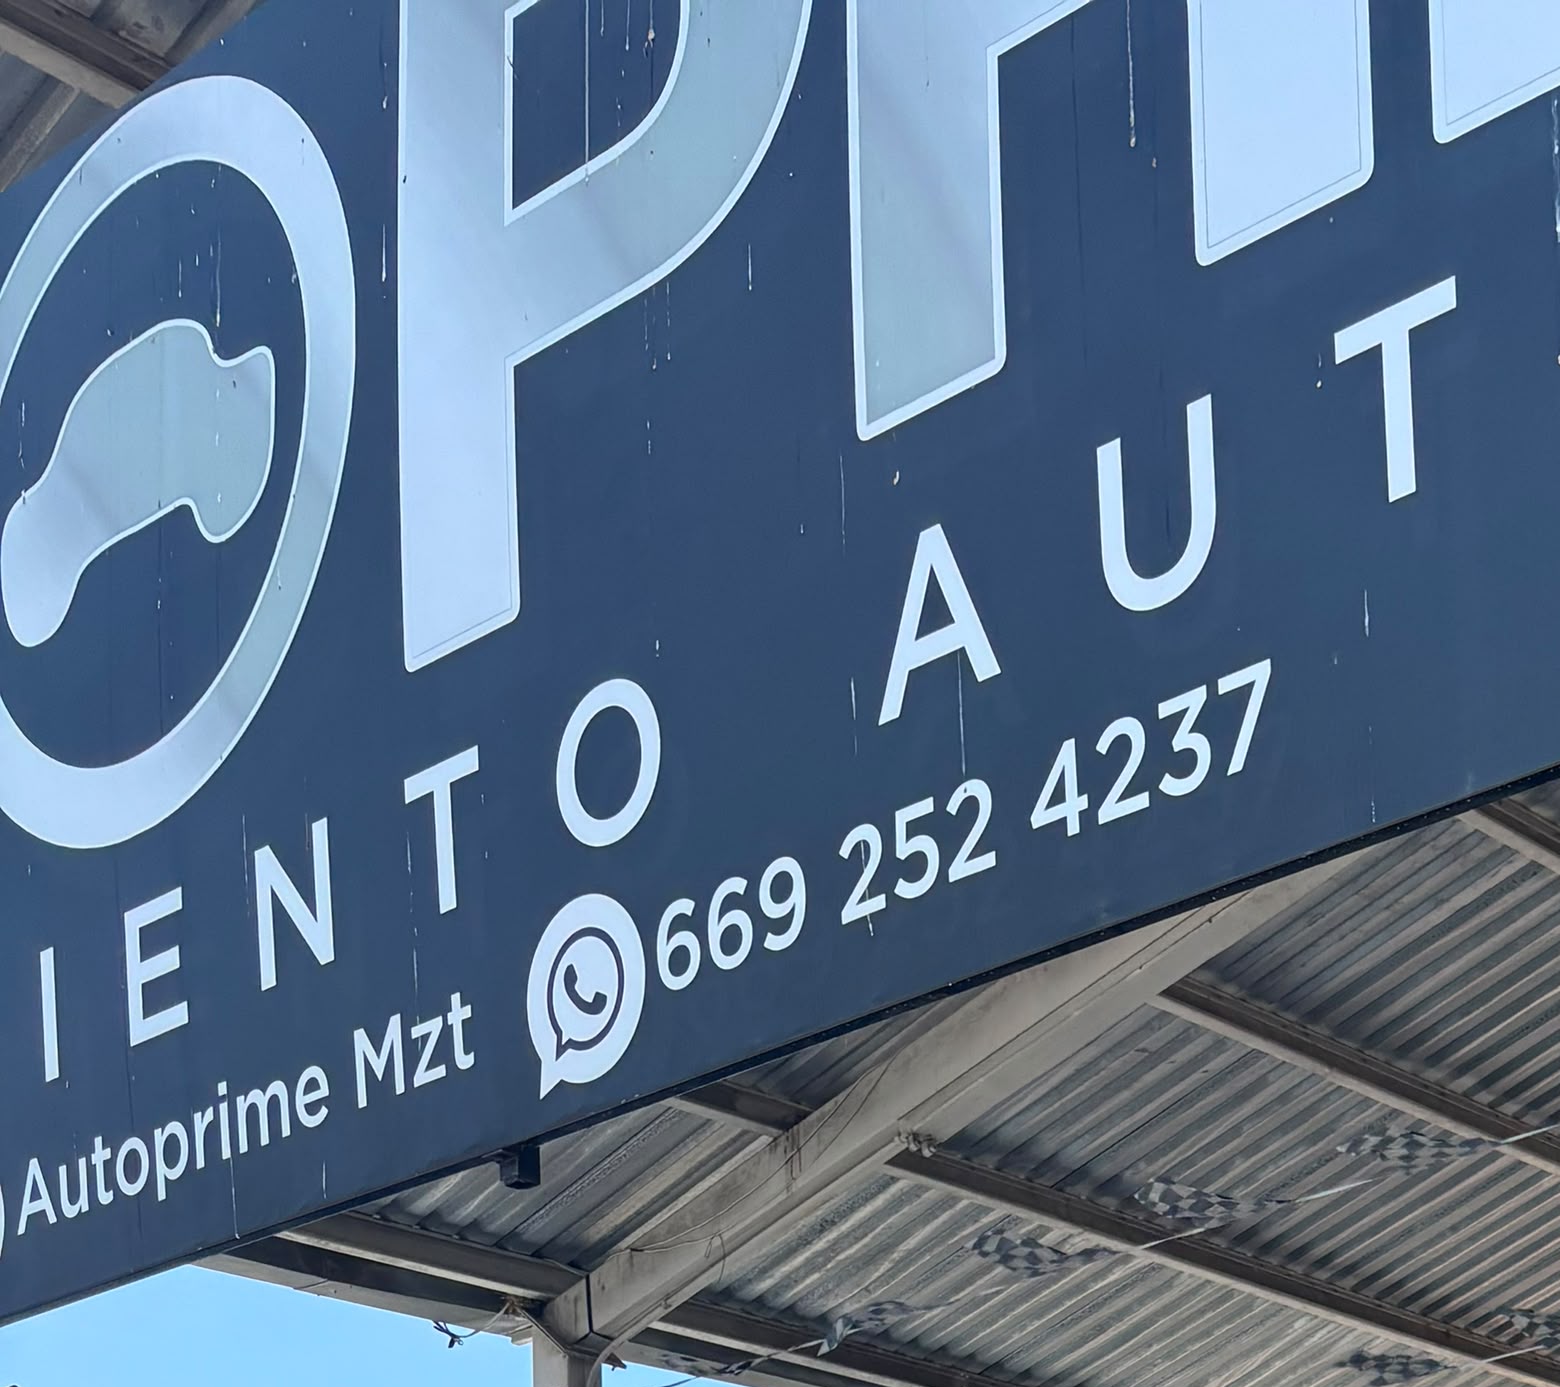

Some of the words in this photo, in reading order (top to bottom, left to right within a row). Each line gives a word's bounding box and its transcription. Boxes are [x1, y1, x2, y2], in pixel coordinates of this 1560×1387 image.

[657, 857, 805, 990] 669
[839, 779, 995, 924] 252
[1031, 659, 1271, 836] 4237
[18, 1066, 329, 1235] Autoprime
[354, 993, 474, 1108] Mzt
